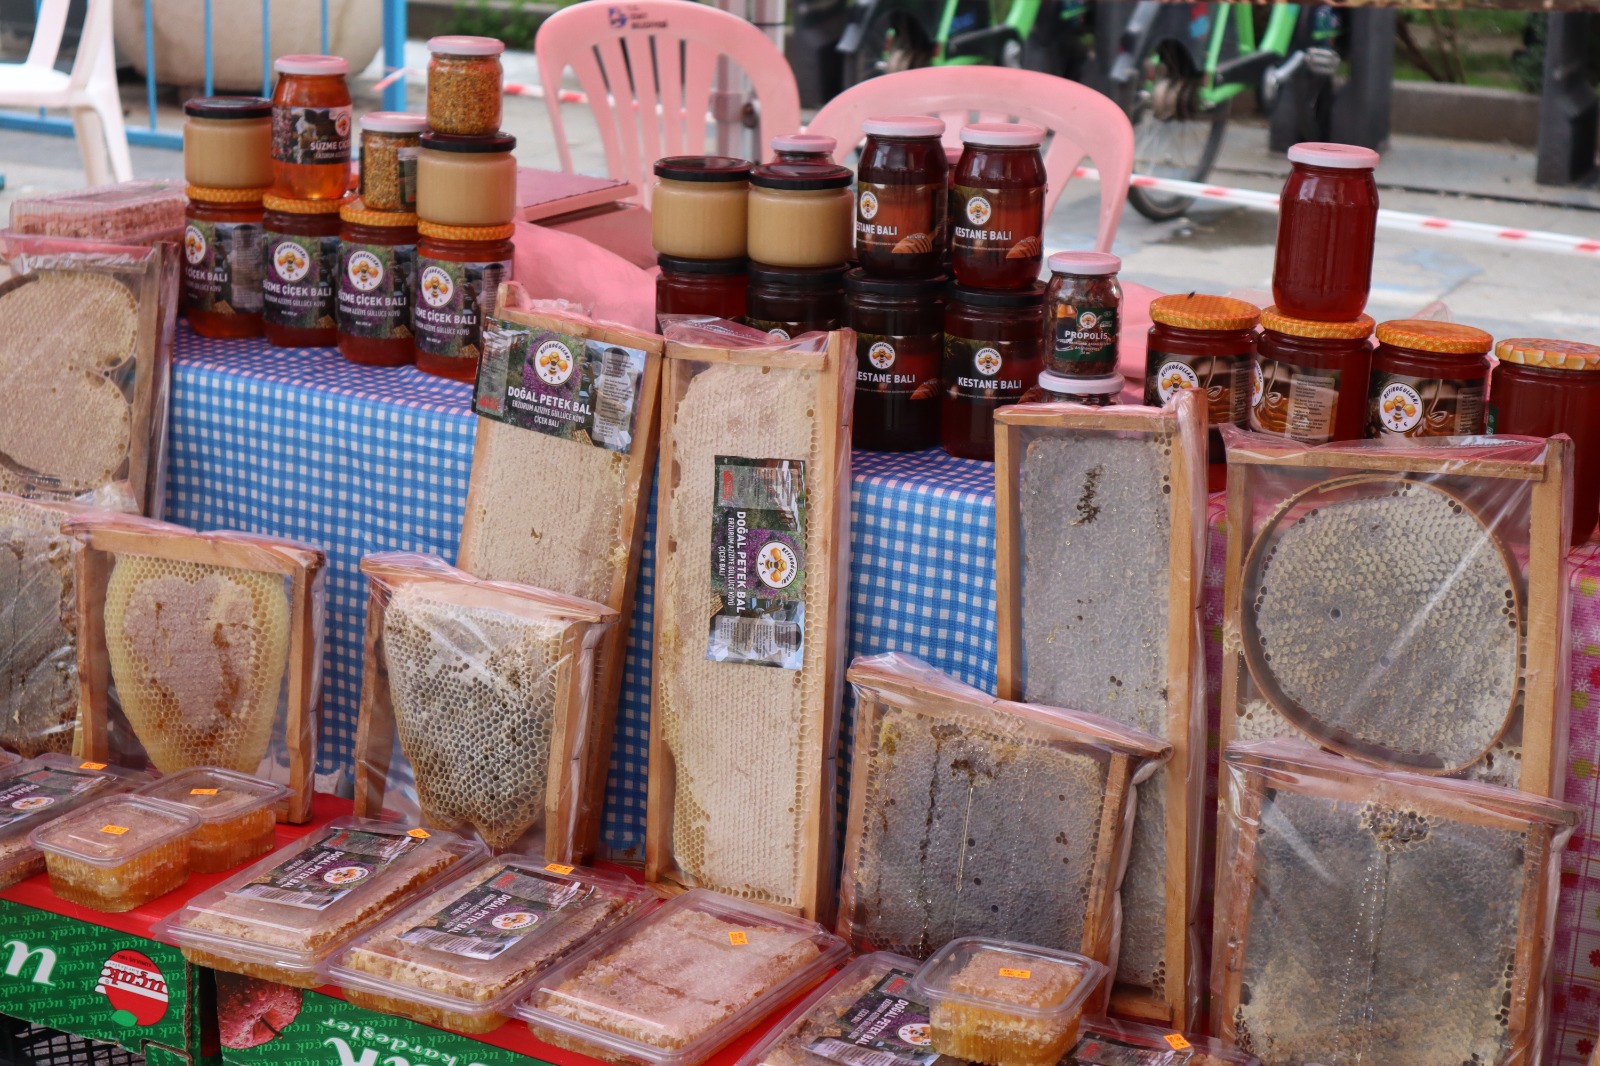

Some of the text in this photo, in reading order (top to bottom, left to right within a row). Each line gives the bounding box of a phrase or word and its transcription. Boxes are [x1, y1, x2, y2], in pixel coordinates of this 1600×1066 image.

[310, 140, 337, 151] SÜZME
[856, 222, 898, 236] ESTANE BALI
[955, 226, 988, 240] KESTANE
[990, 230, 1012, 241] BALI
[207, 272, 228, 282] BALI
[282, 282, 308, 297] ÇİÇEK
[310, 287, 332, 296] BALI
[356, 294, 382, 306] ÇİÇEK
[385, 297, 406, 306] BALI
[428, 310, 452, 324] ÇİÇEK
[454, 316, 476, 324] BALI
[1064, 330, 1108, 340] PROPOLİS
[894, 374, 916, 384] BALI
[958, 376, 1022, 390] KESTANE BALI
[508, 385, 592, 416] DOĞAL PETEK BAL
[736, 511, 749, 613] DOĞAL PETEK BAL
[294, 865, 322, 880] PETEK
[484, 894, 512, 910] DOĞAL
[461, 910, 490, 925] PETEK
[51, 926, 86, 940] uçak
[72, 941, 107, 956] uçak
[60, 961, 95, 975] uçak
[108, 966, 168, 994] uçak
[1, 984, 35, 998] uçak
[28, 998, 63, 1013] uçak
[69, 994, 104, 1009] uçak
[884, 999, 909, 1018] DOĞAL
[49, 1014, 84, 1028] uçak
[870, 1017, 891, 1036] PETEK
[119, 1027, 154, 1040] uçak
[855, 1034, 874, 1045] BAL
[256, 1040, 291, 1055] uçak
[321, 1018, 458, 1066] kardeşler
